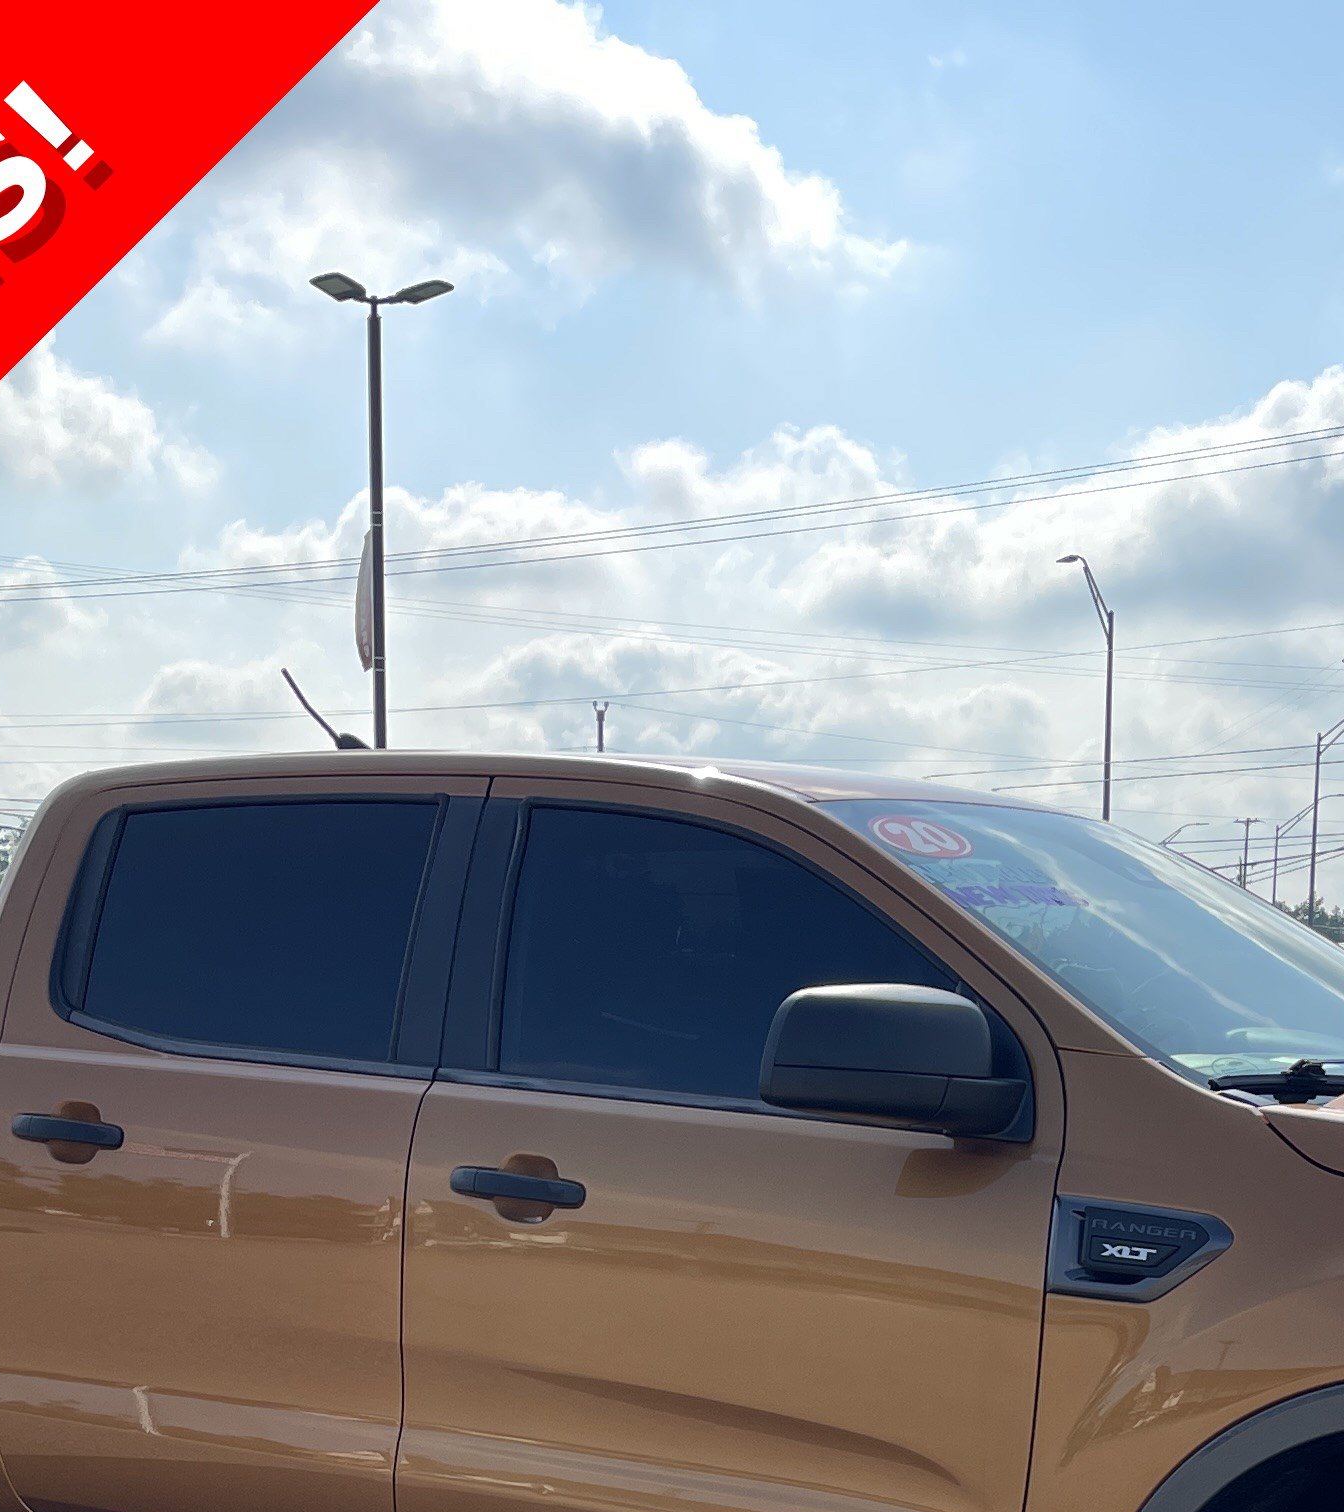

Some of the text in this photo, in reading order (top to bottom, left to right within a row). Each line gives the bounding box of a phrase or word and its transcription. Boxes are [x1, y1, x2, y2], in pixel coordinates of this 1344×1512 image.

[884, 821, 960, 853] 20
[1091, 1218, 1197, 1240] RANGER
[1100, 1243, 1157, 1261] XLT
